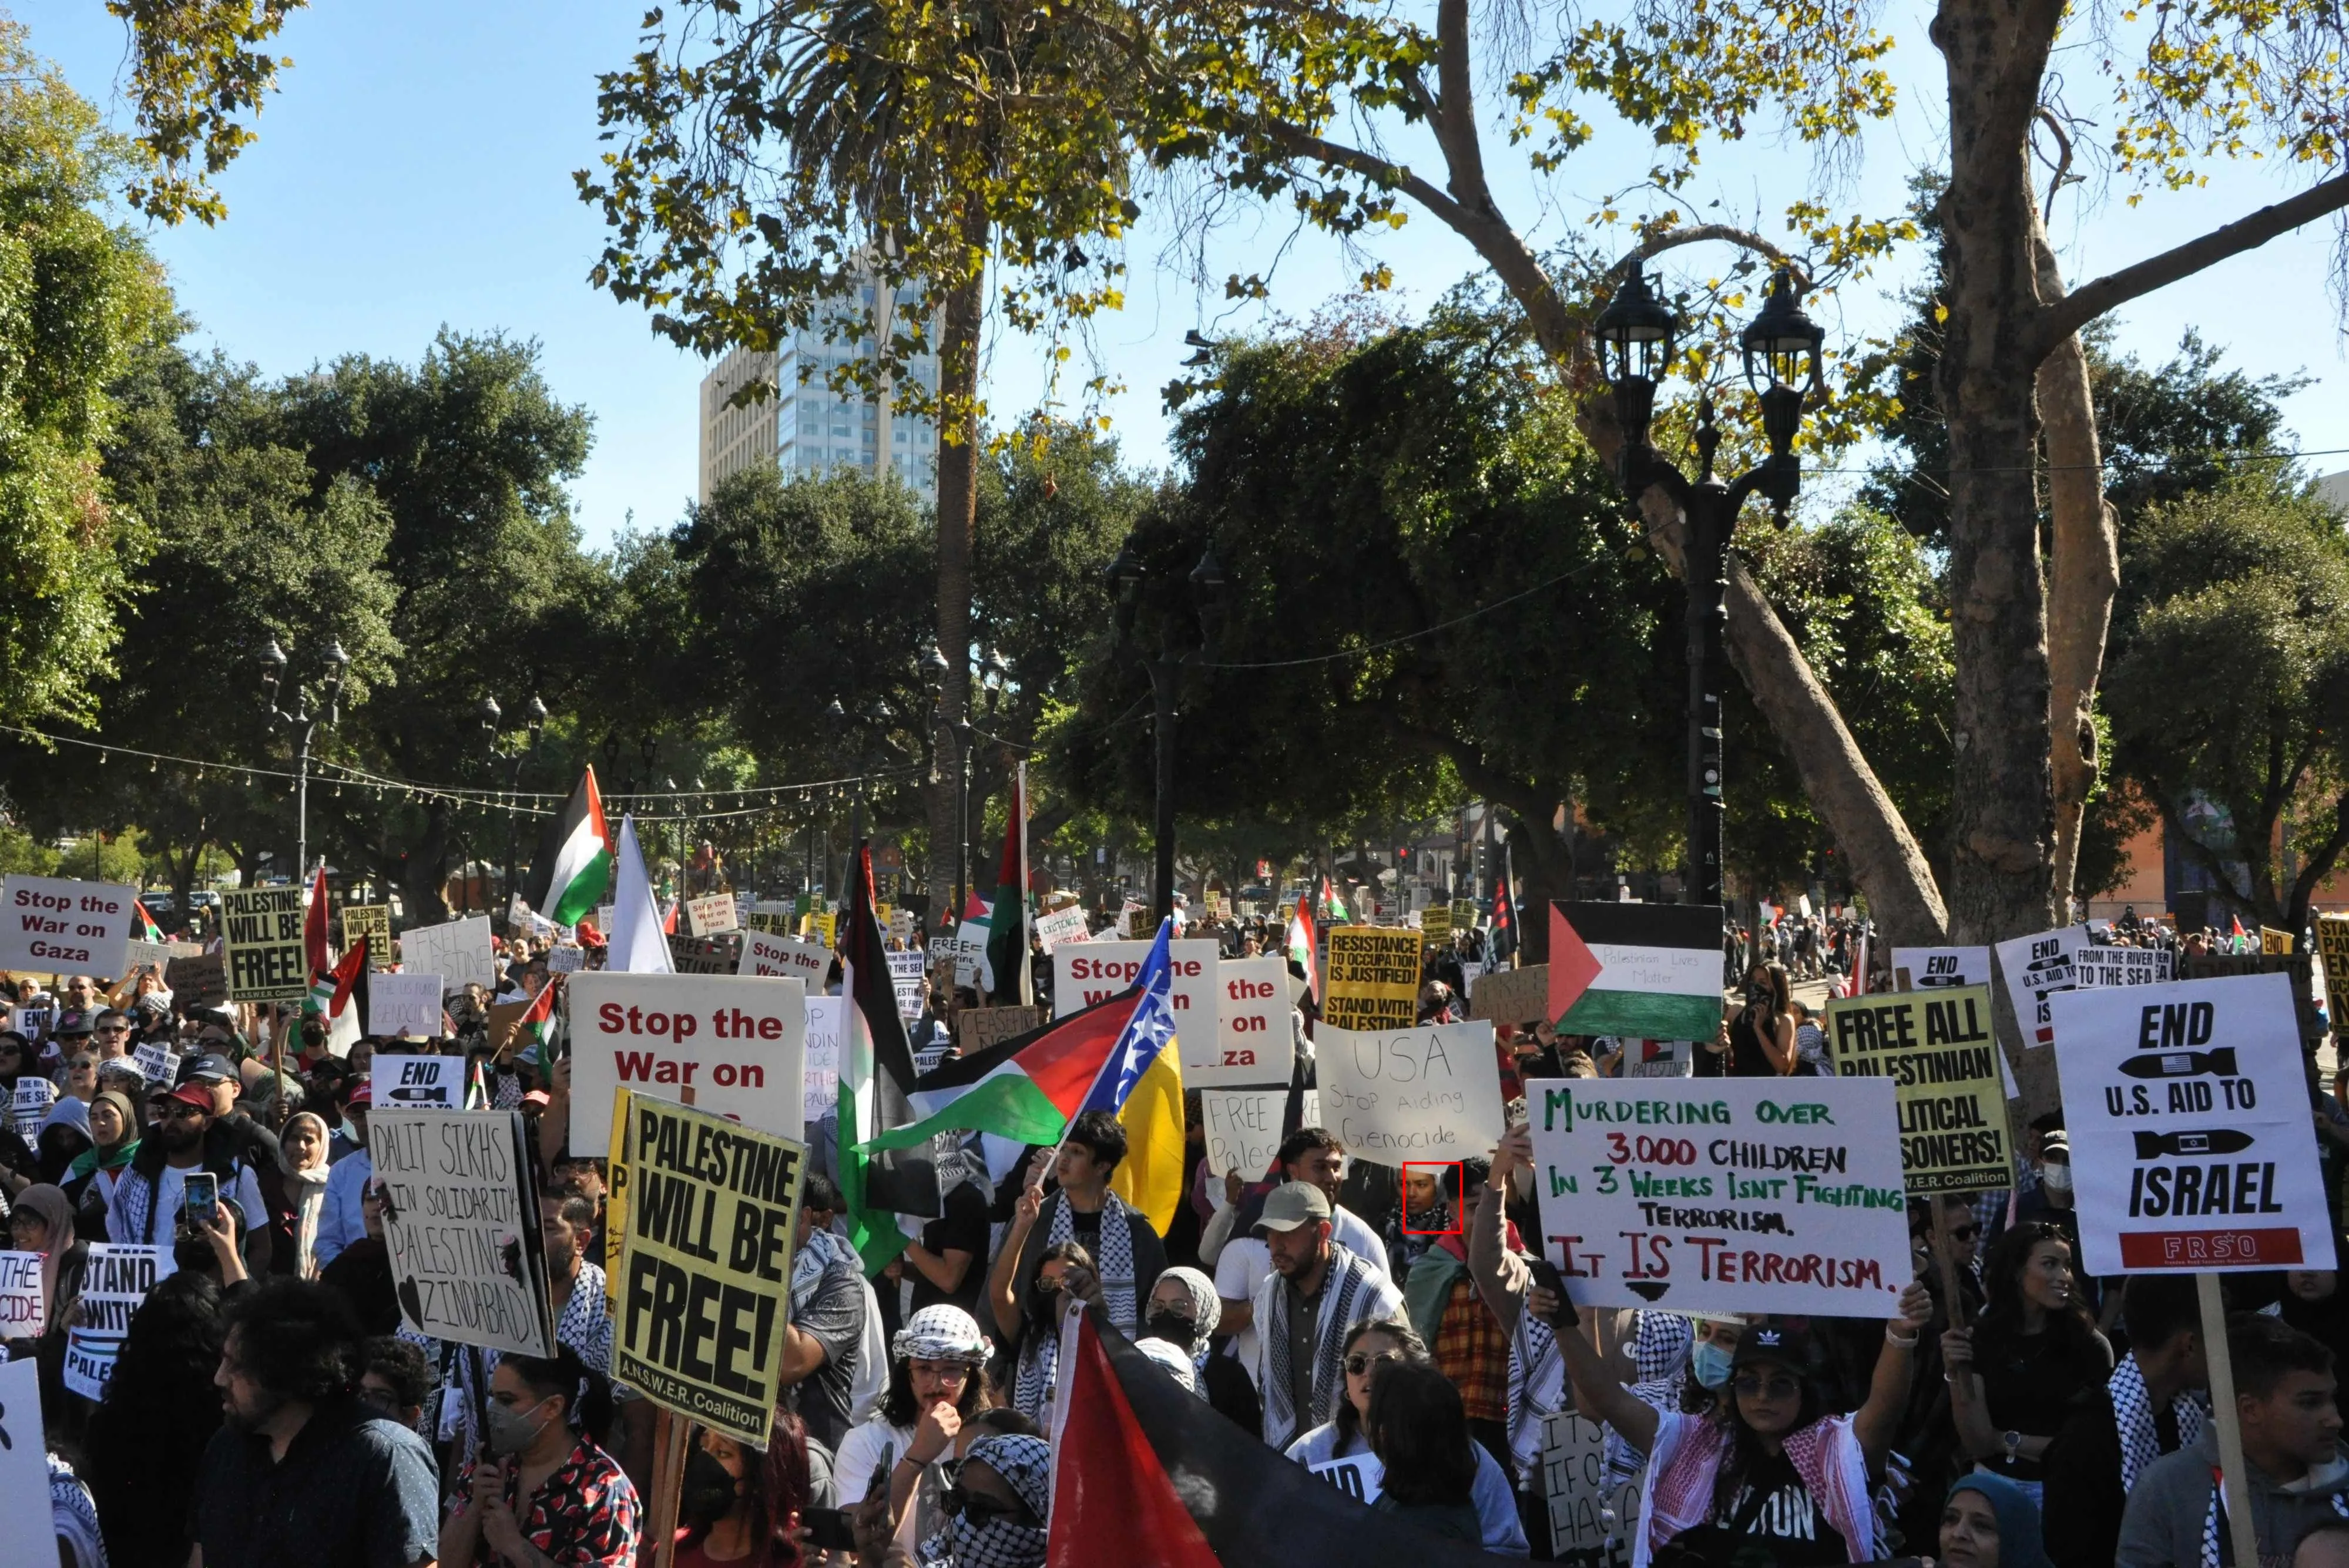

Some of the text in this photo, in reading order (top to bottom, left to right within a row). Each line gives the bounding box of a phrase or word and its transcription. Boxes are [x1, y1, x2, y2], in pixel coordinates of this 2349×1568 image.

[15, 889, 119, 914] Stop the
[224, 890, 301, 915] PALESTINE
[345, 908, 387, 920] PALESTINE
[692, 902, 712, 912] Stop
[22, 915, 105, 938] War on
[227, 913, 301, 944] WILL BE
[374, 919, 387, 933] BE
[750, 913, 769, 925] END
[771, 914, 786, 926] ALL
[30, 941, 89, 962] Gaza
[415, 922, 462, 956] FREE
[675, 936, 704, 955] REE
[932, 939, 969, 953] FREE
[1332, 935, 1418, 954] RESISTANCE
[2032, 938, 2059, 961] END
[230, 945, 304, 988] FREE!
[753, 942, 820, 969] Stop the
[894, 963, 922, 973] THE SEA
[1331, 951, 1344, 965] TO
[1347, 953, 1418, 968] OCCUPATION
[1603, 945, 1699, 967] Palestinian Lives
[1926, 956, 1958, 975] END
[2078, 949, 2153, 965] FROM THE RIVER
[1071, 958, 1140, 983] Stop
[1330, 966, 1415, 984] IS JUSTIFIED!
[1632, 969, 1673, 984] Matter
[2022, 972, 2044, 988] U.S.
[2046, 967, 2064, 982] AID
[2079, 965, 2152, 986] TO THE SEA
[275, 989, 305, 997] Coalition
[1227, 979, 1274, 1000] the
[1328, 996, 1413, 1016] STAND WITH
[598, 1002, 783, 1044] Stop the
[1231, 1015, 1266, 1032] on
[1835, 998, 1989, 1055] FREE ALL
[2139, 1001, 2214, 1050] END
[144, 1061, 162, 1076] THE
[614, 1050, 764, 1089] War on
[1353, 1033, 1452, 1083] USA
[400, 1062, 441, 1085] END
[15, 1092, 31, 1104] THE
[2105, 1077, 2256, 1117] U.S. AID TO
[1209, 1096, 1269, 1133] FREE
[1896, 1094, 1988, 1133] LITICAL
[1342, 1117, 1455, 1150] Genocide
[373, 1122, 508, 1183] DALIT SIKHS
[639, 1108, 798, 1208] PALESTINE
[1708, 1139, 1847, 1174] CHILDREN
[1900, 1129, 2005, 1170] SONERS!
[1593, 1165, 1619, 1195] 3
[1627, 1169, 1713, 1198] WEEKS
[1793, 1173, 1904, 1213] FIGHTING
[1945, 1171, 2006, 1186] Coalition
[2129, 1161, 2283, 1218] ISRAEL
[392, 1183, 521, 1224] IN SOLIDARITY:
[636, 1167, 787, 1284] WILL BE
[389, 1221, 509, 1277] PALESTINE
[1619, 1230, 1673, 1280] IS
[2164, 1235, 2256, 1259] FRSO
[2, 1257, 40, 1288] THE
[82, 1256, 156, 1294] STAND
[418, 1279, 542, 1349] ZINDABAD!
[624, 1249, 777, 1402] FREE!
[622, 1358, 761, 1429] A.N.S.W.E.R. Coalition
